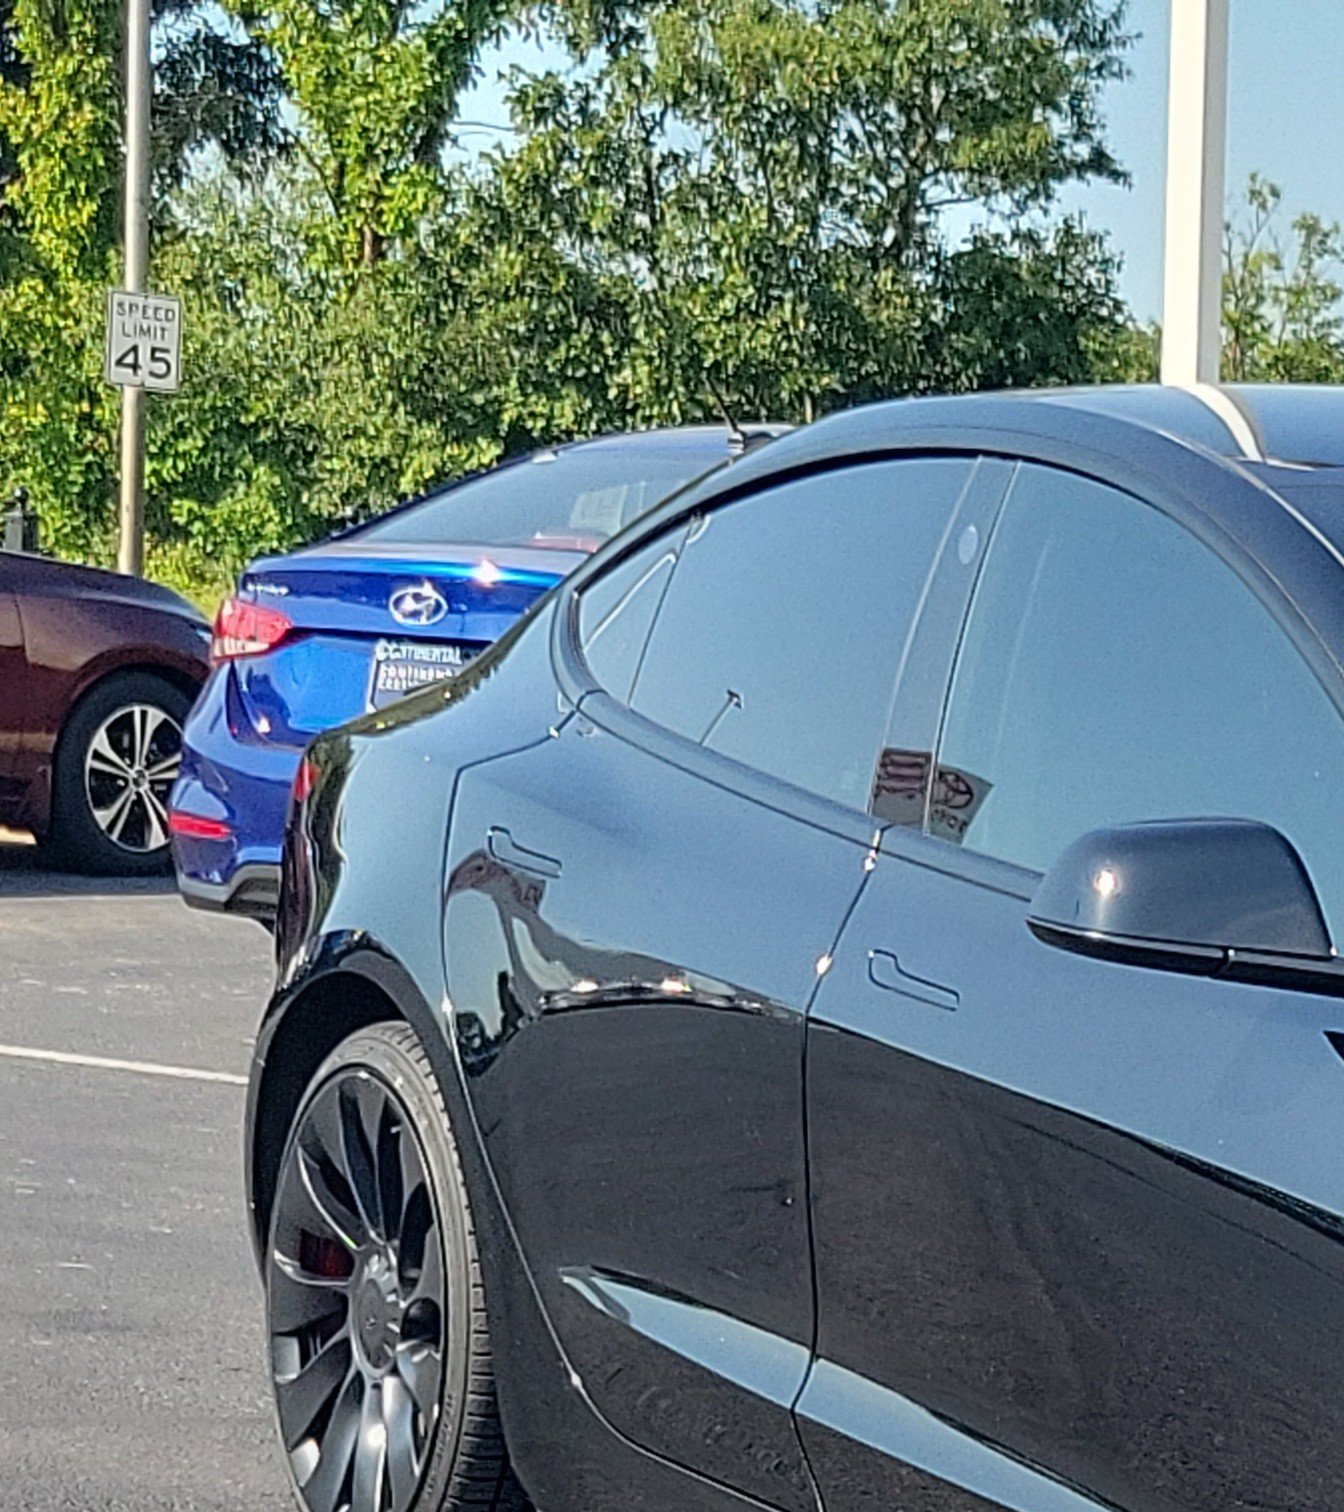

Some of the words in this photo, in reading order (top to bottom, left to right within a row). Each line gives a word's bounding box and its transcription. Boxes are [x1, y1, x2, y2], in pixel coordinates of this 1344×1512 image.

[116, 302, 176, 322] SPEED
[122, 322, 168, 341] LIMIT
[114, 343, 172, 380] 45
